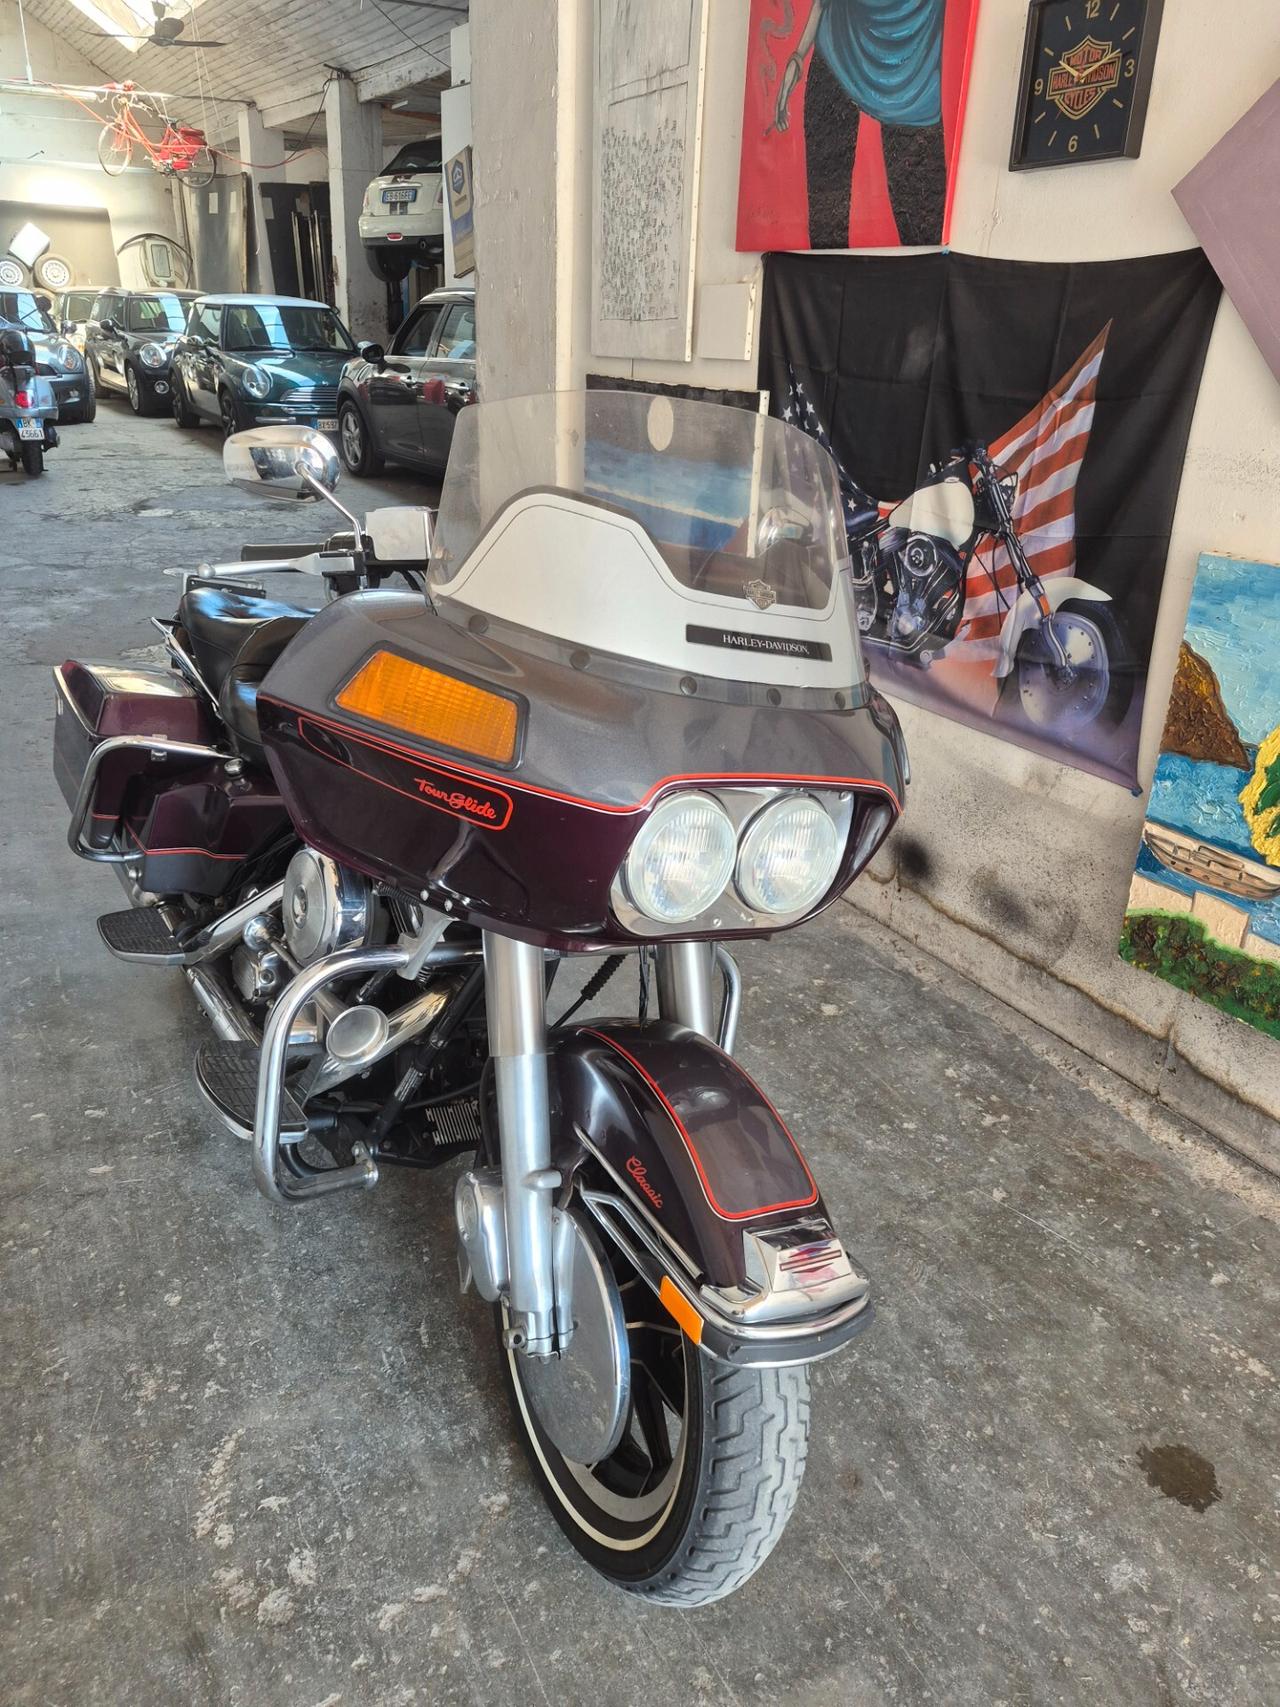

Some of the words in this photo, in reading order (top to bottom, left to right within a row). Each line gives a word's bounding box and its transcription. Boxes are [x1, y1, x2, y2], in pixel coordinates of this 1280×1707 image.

[1085, 0, 1101, 19] 12
[1124, 59, 1135, 77] 3
[1034, 78, 1044, 95] 9
[1064, 87, 1097, 110] CYCLES
[1068, 135, 1078, 152] 6
[722, 633, 809, 654] HARLEY-DAVIDSON
[626, 1155, 663, 1208] Classic
